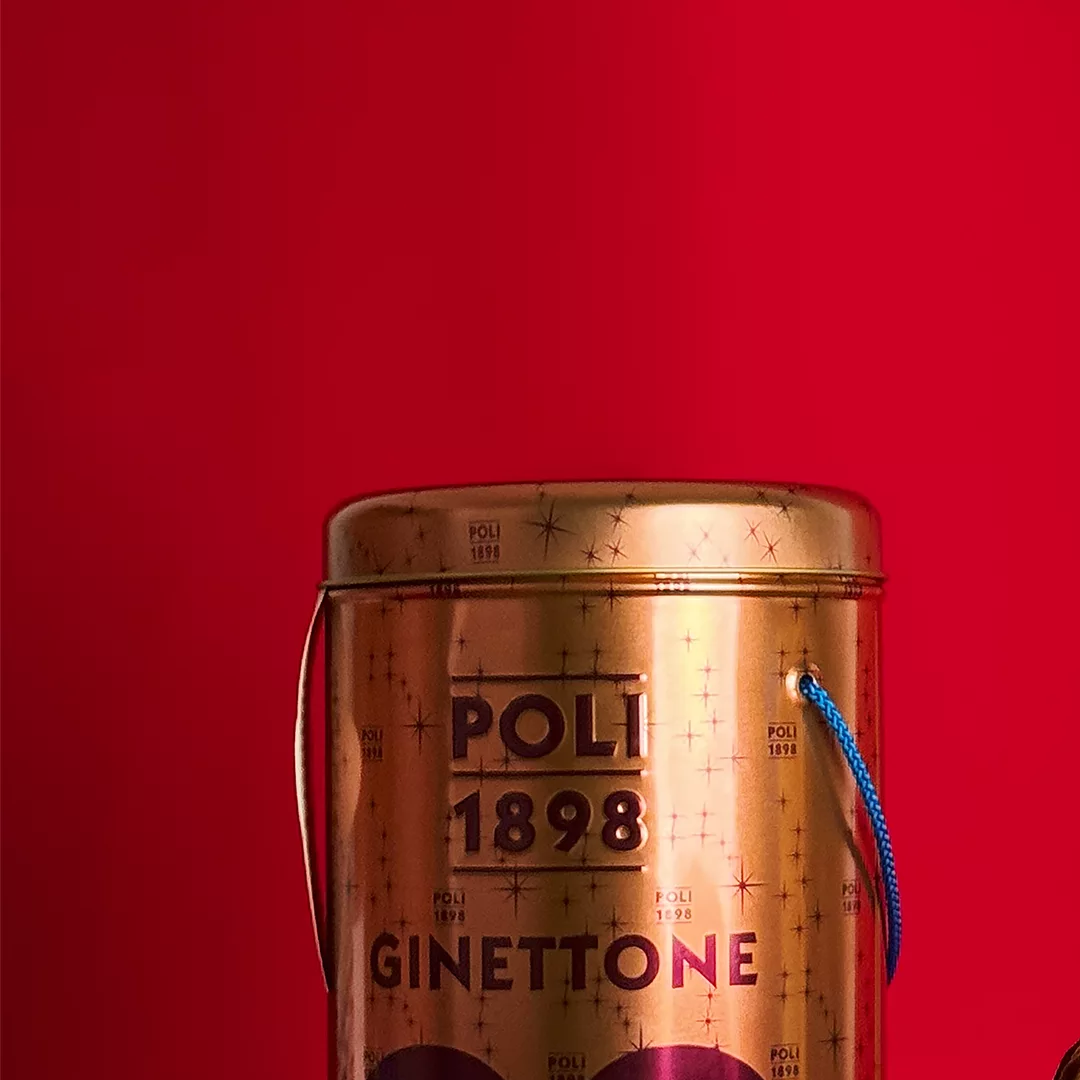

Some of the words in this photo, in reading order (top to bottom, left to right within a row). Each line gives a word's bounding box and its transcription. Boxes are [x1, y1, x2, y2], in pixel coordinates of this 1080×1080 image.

[469, 523, 500, 540] POLI
[471, 544, 500, 560] 1898
[452, 693, 647, 759] POLI
[768, 725, 797, 738] POLI
[768, 743, 797, 755] 1898
[453, 789, 648, 854] 1898
[433, 891, 466, 905] POLI
[655, 890, 692, 903] POLI
[655, 908, 692, 920] 1898
[370, 931, 758, 991] GINETTONE
[770, 1047, 799, 1061] POLI
[547, 1056, 586, 1070] POLI
[771, 1064, 799, 1078] 1898
